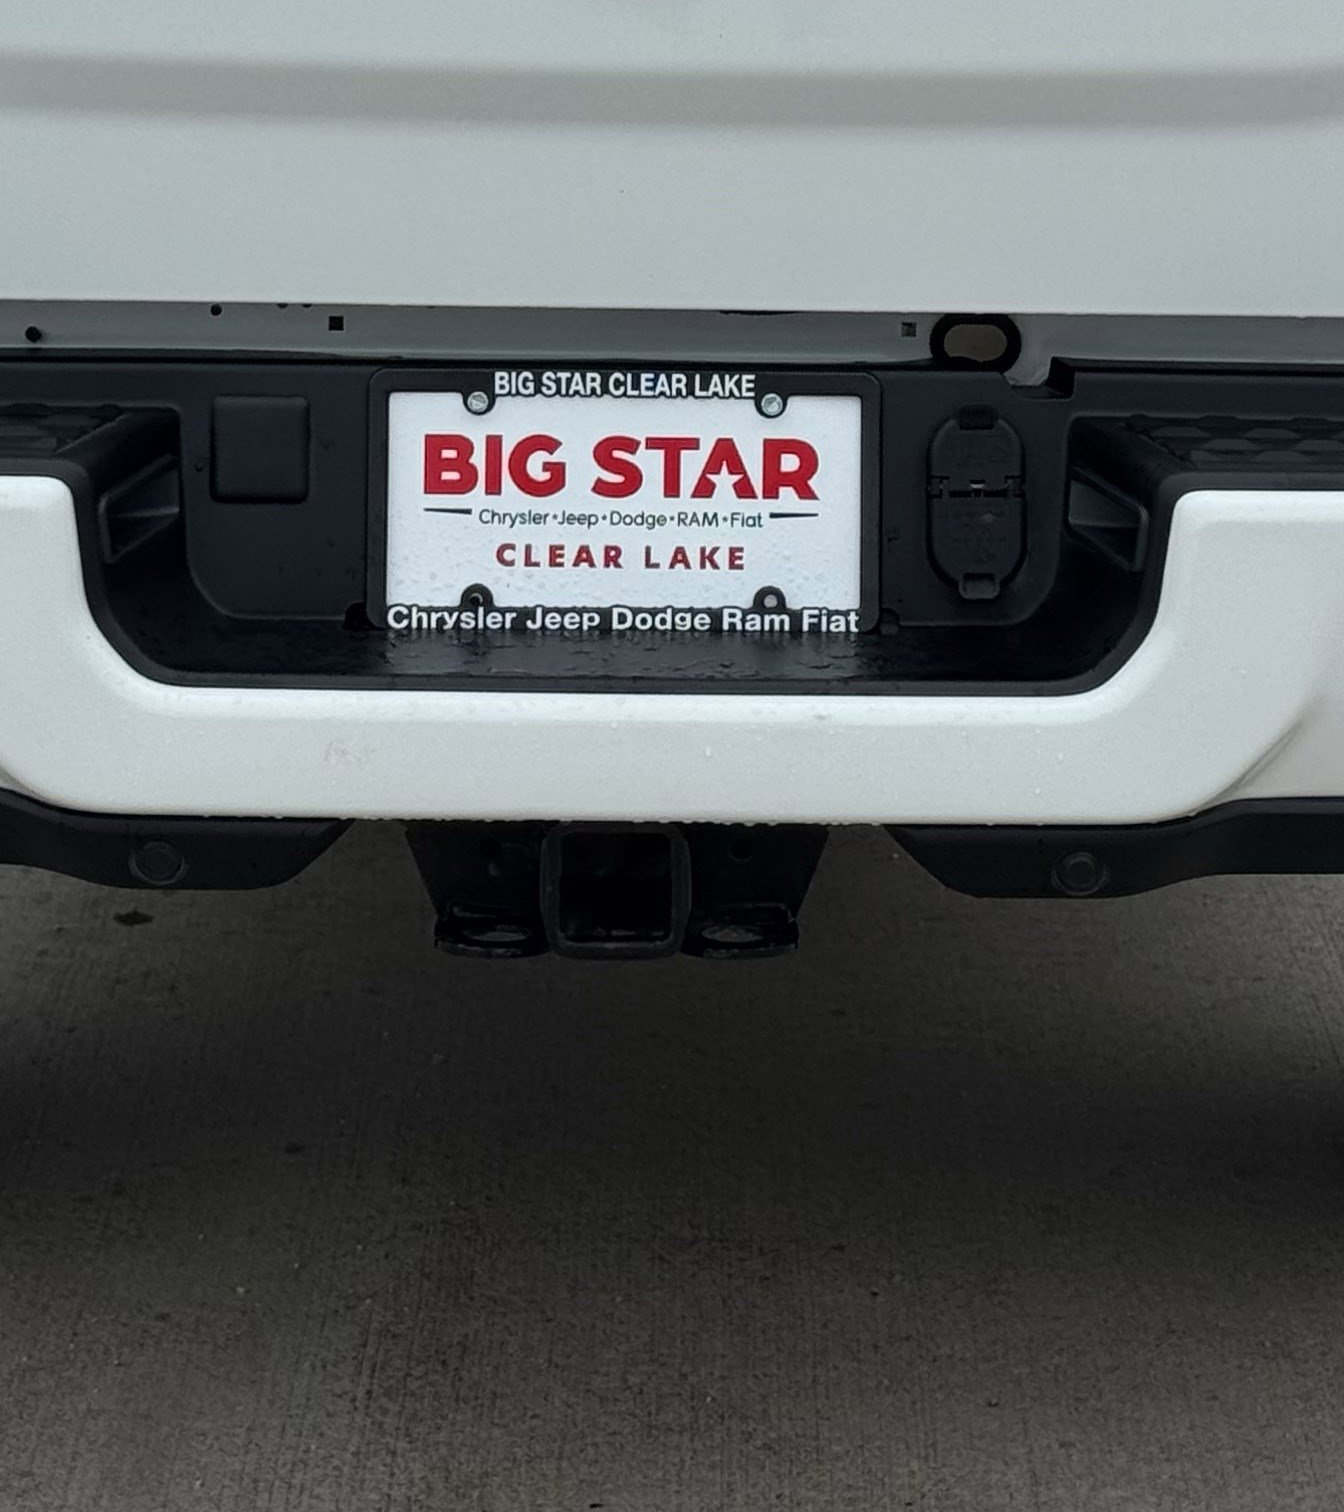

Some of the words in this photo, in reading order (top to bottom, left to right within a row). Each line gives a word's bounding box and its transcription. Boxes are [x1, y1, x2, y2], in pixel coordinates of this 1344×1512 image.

[494, 371, 535, 396] BIG
[541, 372, 601, 396] STAR
[609, 373, 687, 397] CLEAR
[694, 373, 756, 398] LAKE
[423, 433, 567, 498] BIG
[590, 435, 821, 501] STAR
[478, 508, 550, 528] Chrysler
[557, 510, 599, 529] Jeep
[609, 510, 668, 530] Dodge
[676, 511, 719, 528] RAM
[730, 511, 763, 528] Fiat
[495, 543, 624, 569] CLEAR
[644, 544, 745, 570] LAKE
[387, 606, 517, 631] Chrysler
[525, 606, 601, 631] Jeep
[611, 607, 712, 631] Dodge
[721, 608, 791, 632] Ram
[801, 609, 860, 633] Fiat
